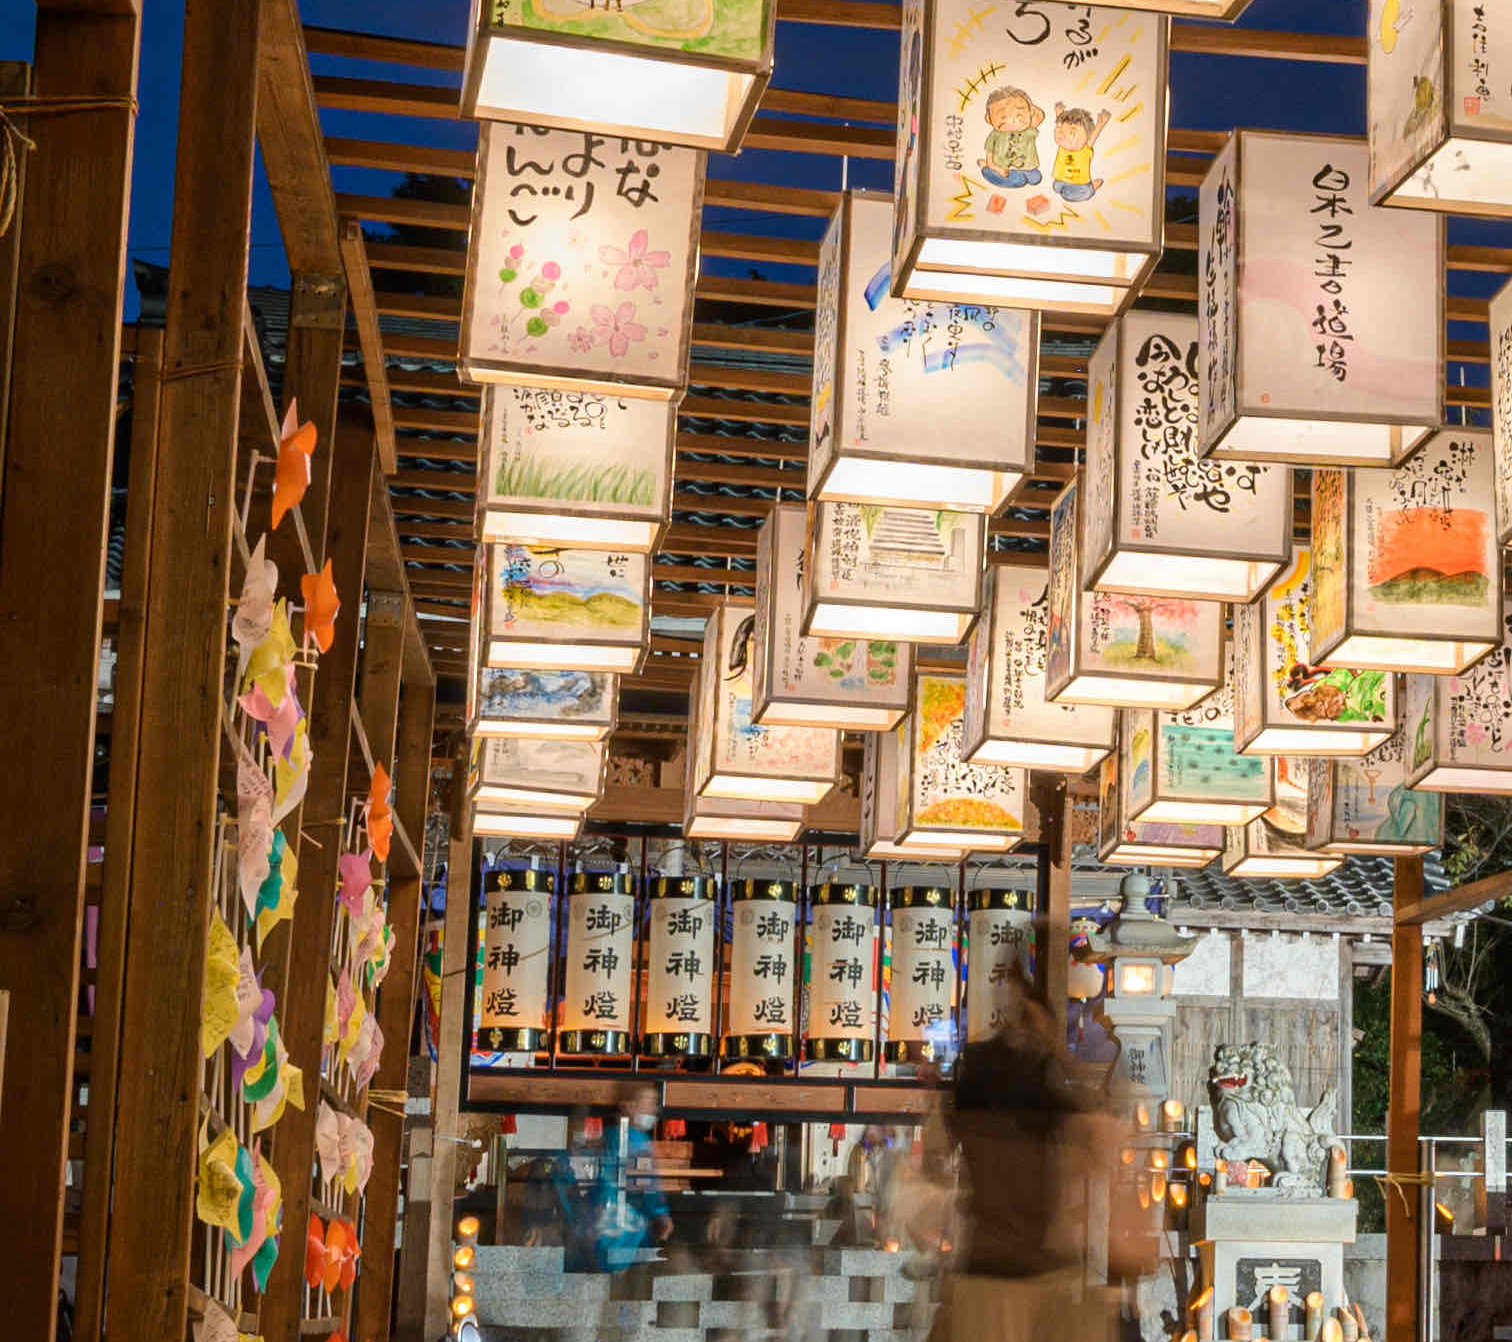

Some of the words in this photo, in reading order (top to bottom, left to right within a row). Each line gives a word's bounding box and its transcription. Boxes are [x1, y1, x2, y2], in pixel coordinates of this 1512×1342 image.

[581, 907, 622, 1022] 御神燈
[664, 911, 704, 1023] 御神燈
[753, 911, 790, 1026] 御神燈
[828, 914, 866, 1029] 御神燈
